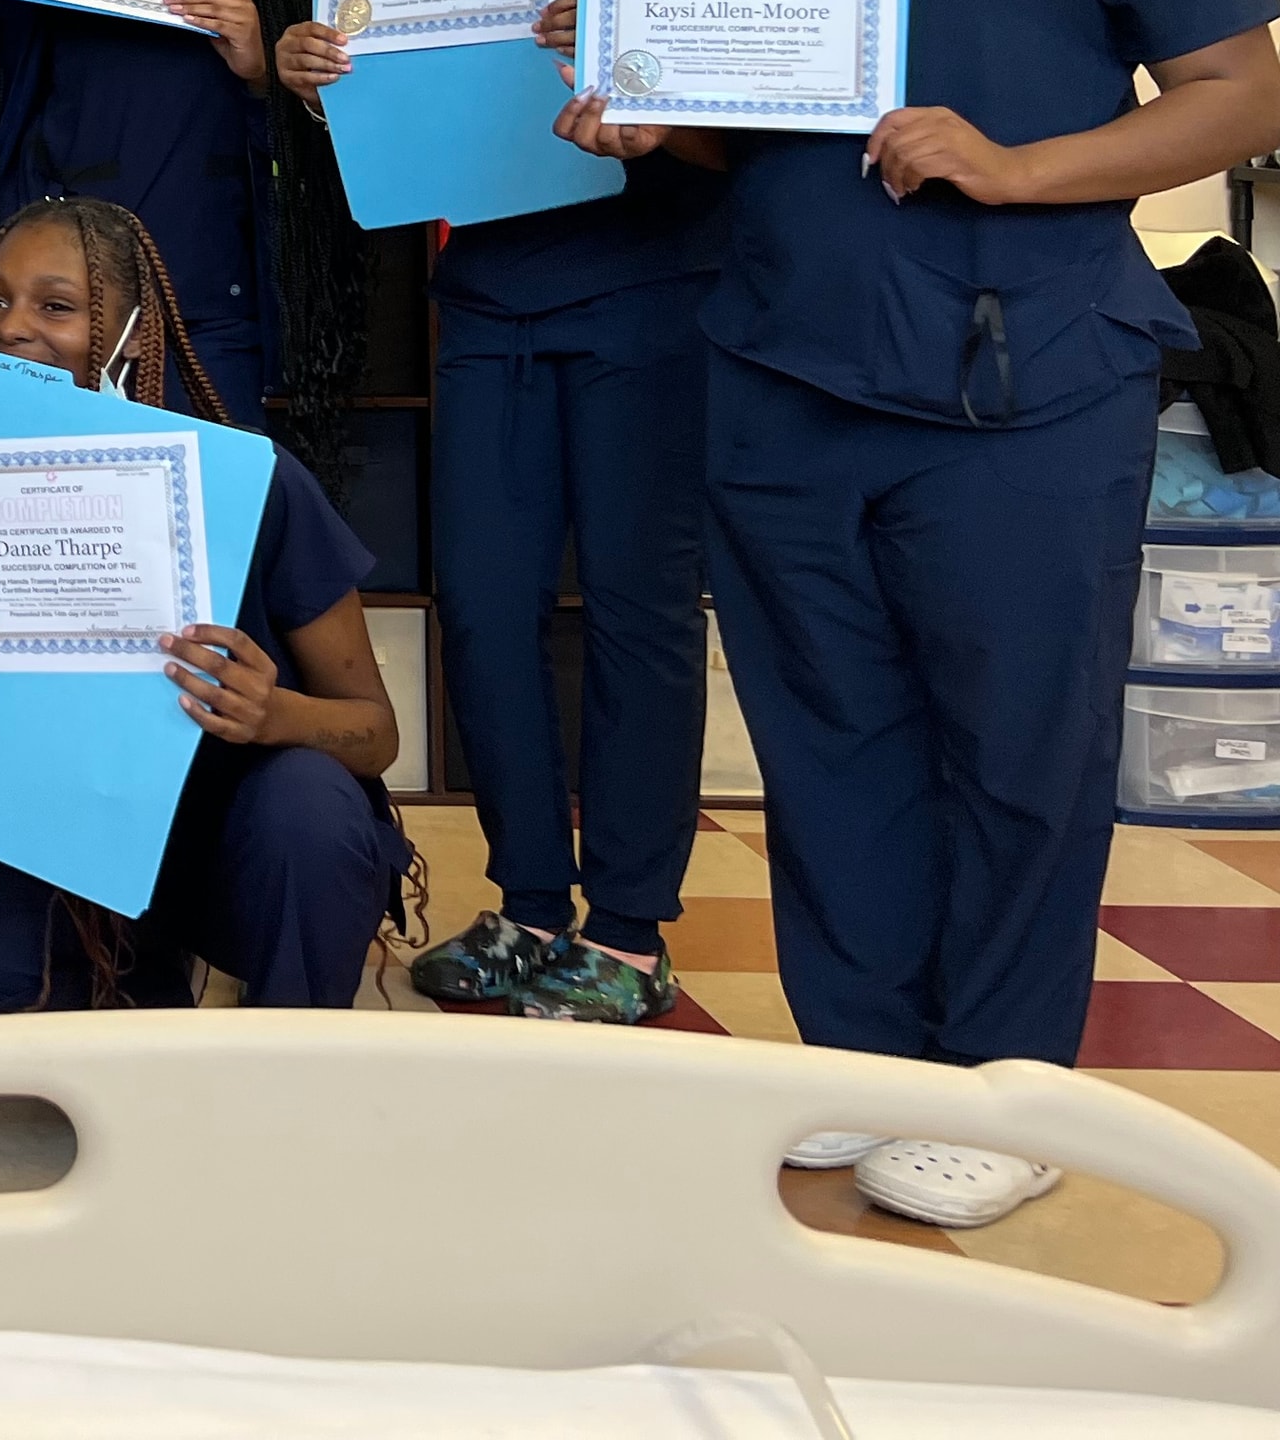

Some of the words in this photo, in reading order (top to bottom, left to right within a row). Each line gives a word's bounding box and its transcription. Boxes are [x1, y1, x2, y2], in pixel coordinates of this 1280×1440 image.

[645, 2, 696, 22] Kaysi
[702, 2, 830, 19] Allen-Moore
[70, 526, 110, 534] AWARDED
[56, 539, 122, 559] Tharpe
[54, 563, 105, 571] COMPLETION
[107, 562, 118, 570] OF
